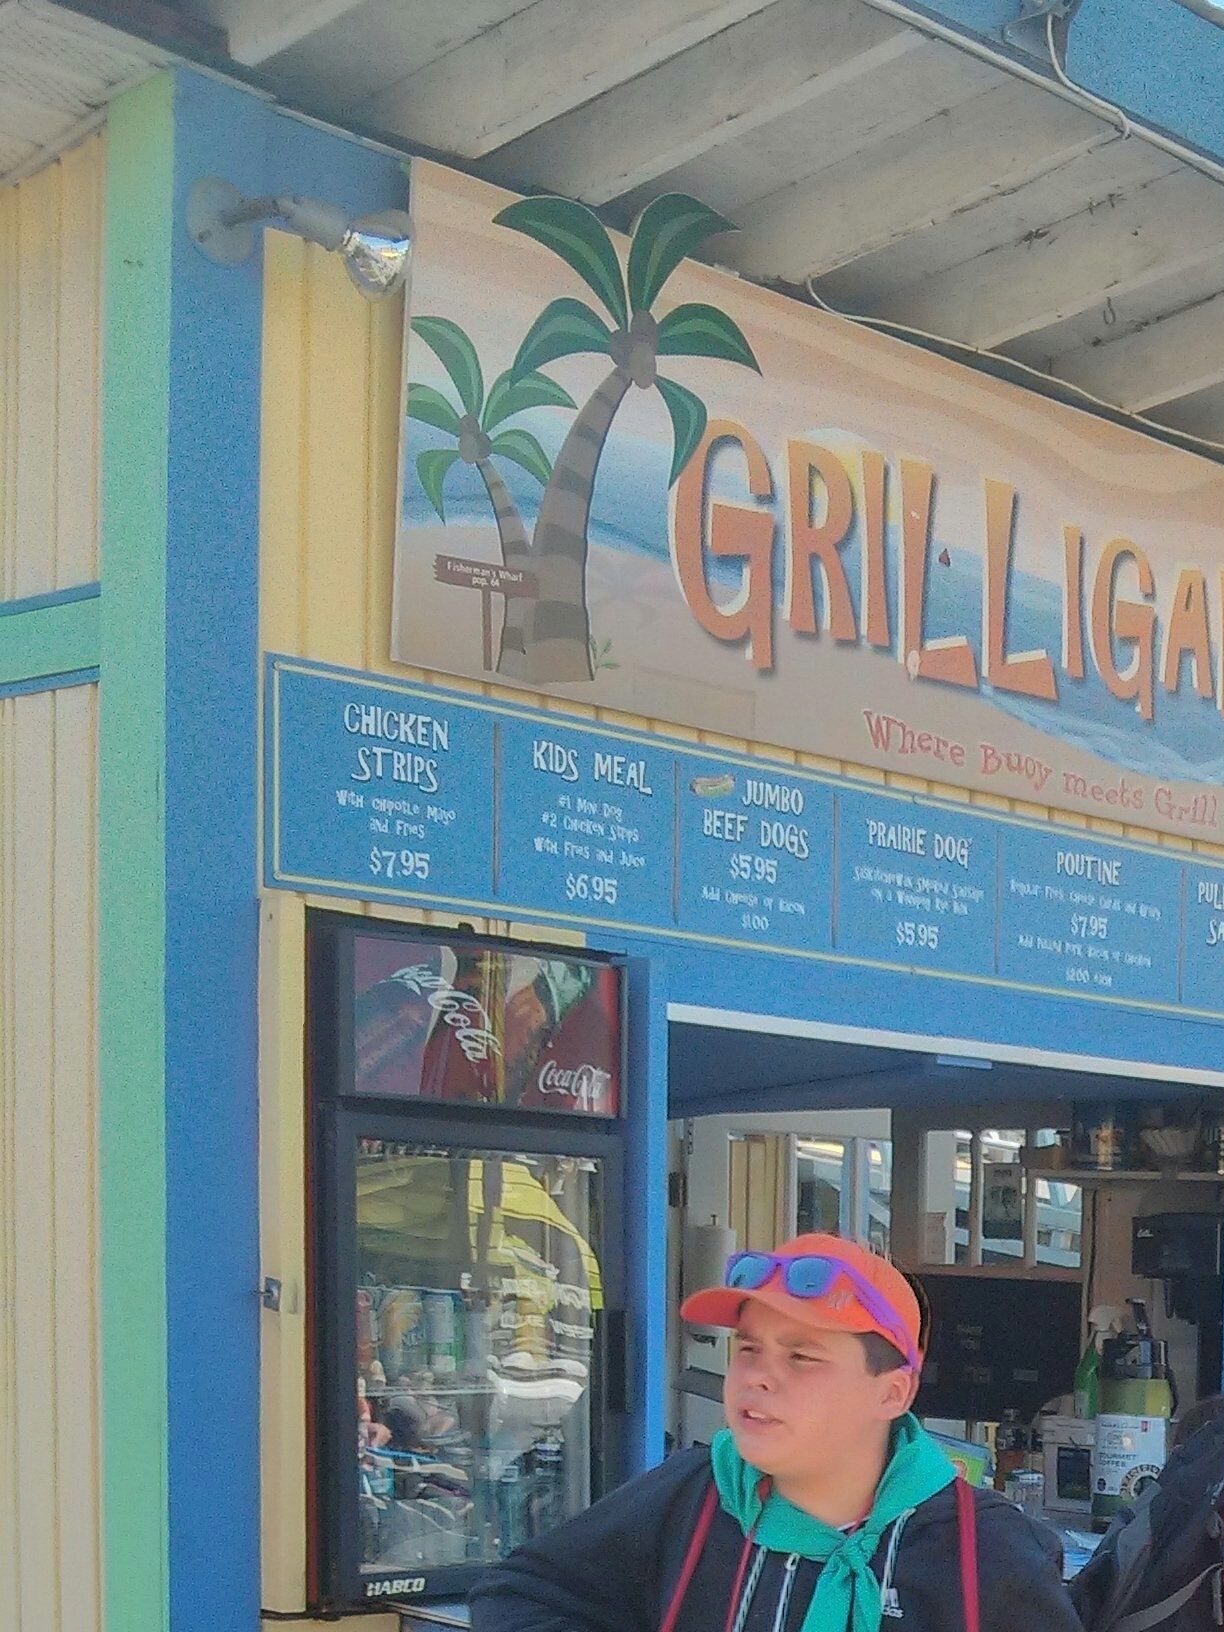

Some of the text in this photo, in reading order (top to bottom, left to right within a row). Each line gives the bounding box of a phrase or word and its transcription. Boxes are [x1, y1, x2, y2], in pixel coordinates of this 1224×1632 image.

[447, 561, 523, 582] Fisherman's Wharf
[343, 703, 450, 751] CHICKEN
[350, 746, 439, 794] STRIPS
[531, 740, 653, 796] KIDS MEAL
[863, 709, 1218, 827] Where Buoy meets Grill
[741, 779, 805, 815] JUMBO
[541, 811, 557, 828] #2
[702, 809, 810, 860] BEEF DOGS
[565, 872, 618, 904] $6.95
[1056, 851, 1122, 886] POUTINE
